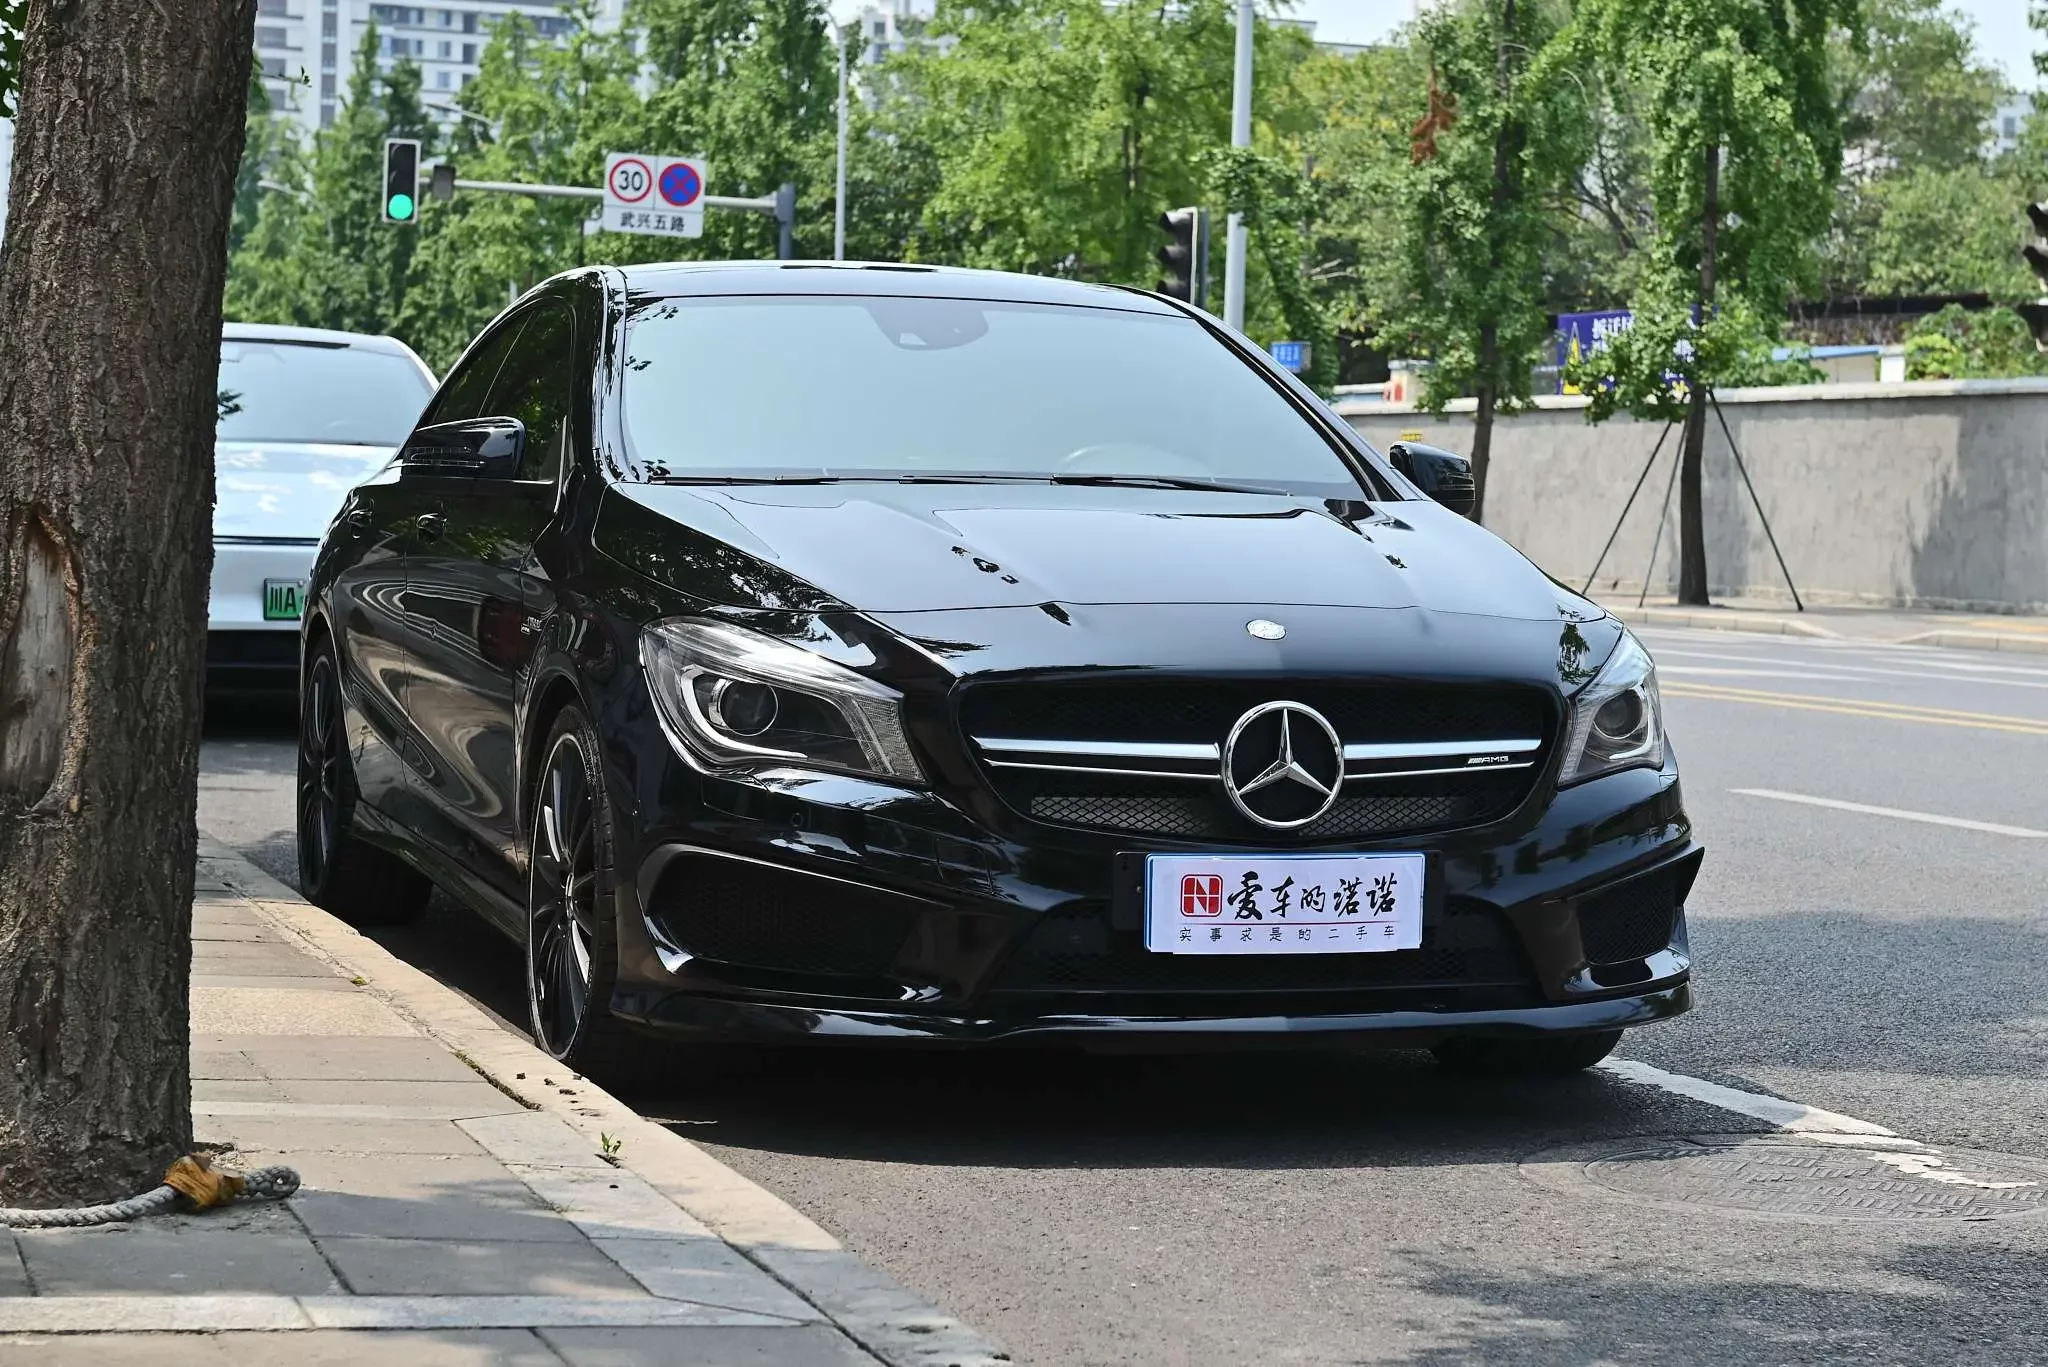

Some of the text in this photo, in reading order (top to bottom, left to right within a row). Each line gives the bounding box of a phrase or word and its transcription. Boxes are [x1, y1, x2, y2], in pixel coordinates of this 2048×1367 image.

[619, 170, 643, 192] 30
[620, 211, 686, 233] 武兴五路
[1481, 755, 1509, 764] AMG
[1227, 871, 1398, 920] 爱车的诺诺
[1179, 925, 1395, 942] 实事求是的二手车
